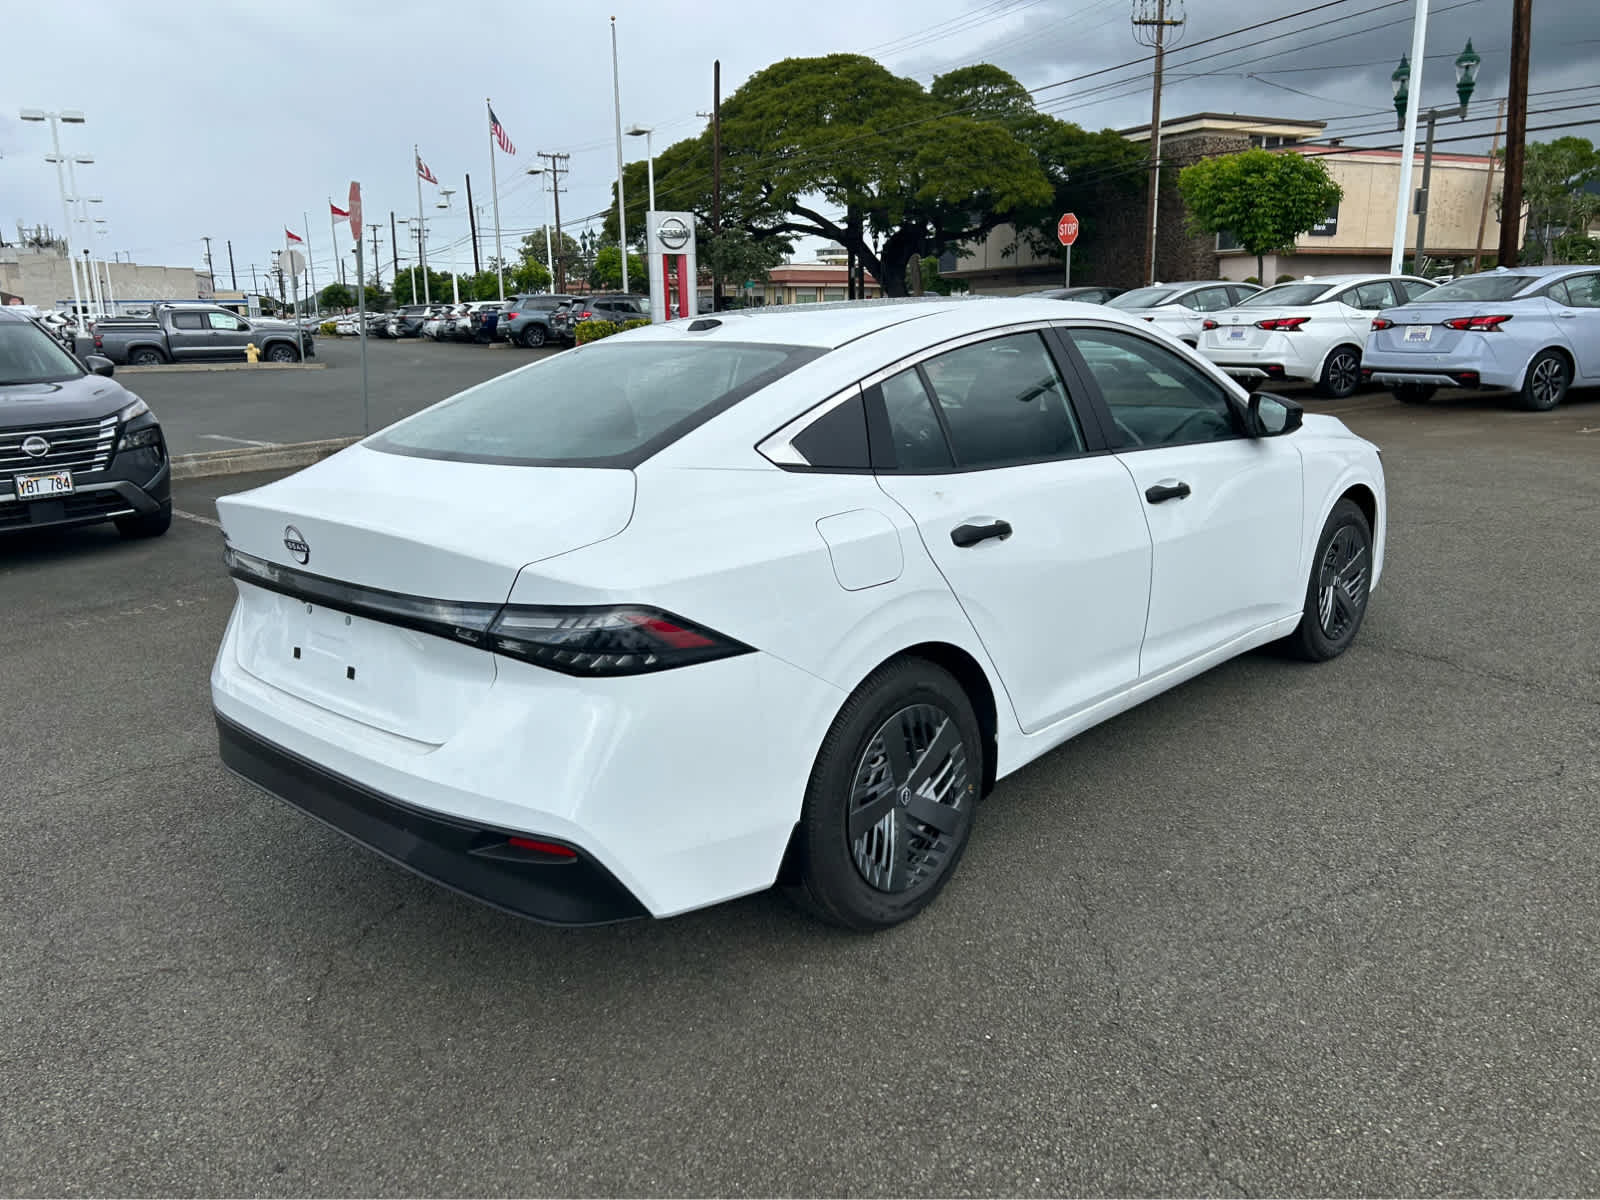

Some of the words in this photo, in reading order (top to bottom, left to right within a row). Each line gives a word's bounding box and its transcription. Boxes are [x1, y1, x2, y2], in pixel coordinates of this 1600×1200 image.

[1059, 223, 1077, 236] STOP
[1313, 223, 1326, 231] Bank
[19, 479, 40, 494] YBT
[48, 476, 70, 492] 784
